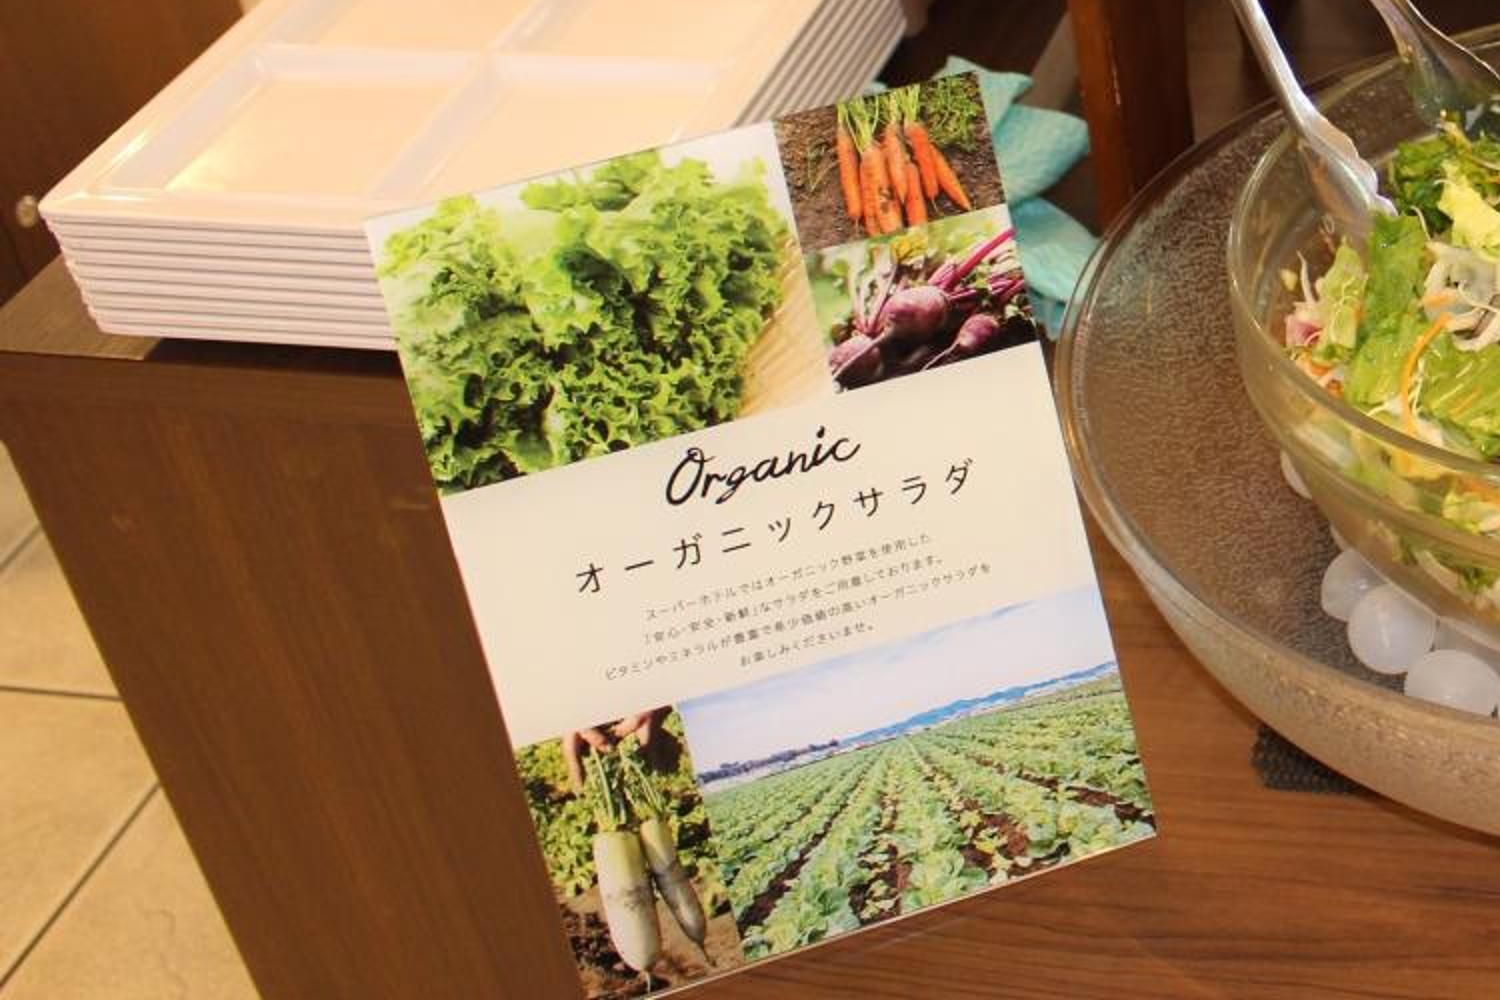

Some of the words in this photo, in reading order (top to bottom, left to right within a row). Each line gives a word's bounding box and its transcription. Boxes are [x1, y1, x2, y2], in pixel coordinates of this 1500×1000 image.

[665, 425, 862, 507] Organic
[576, 457, 974, 595] オーガニックサラダ
